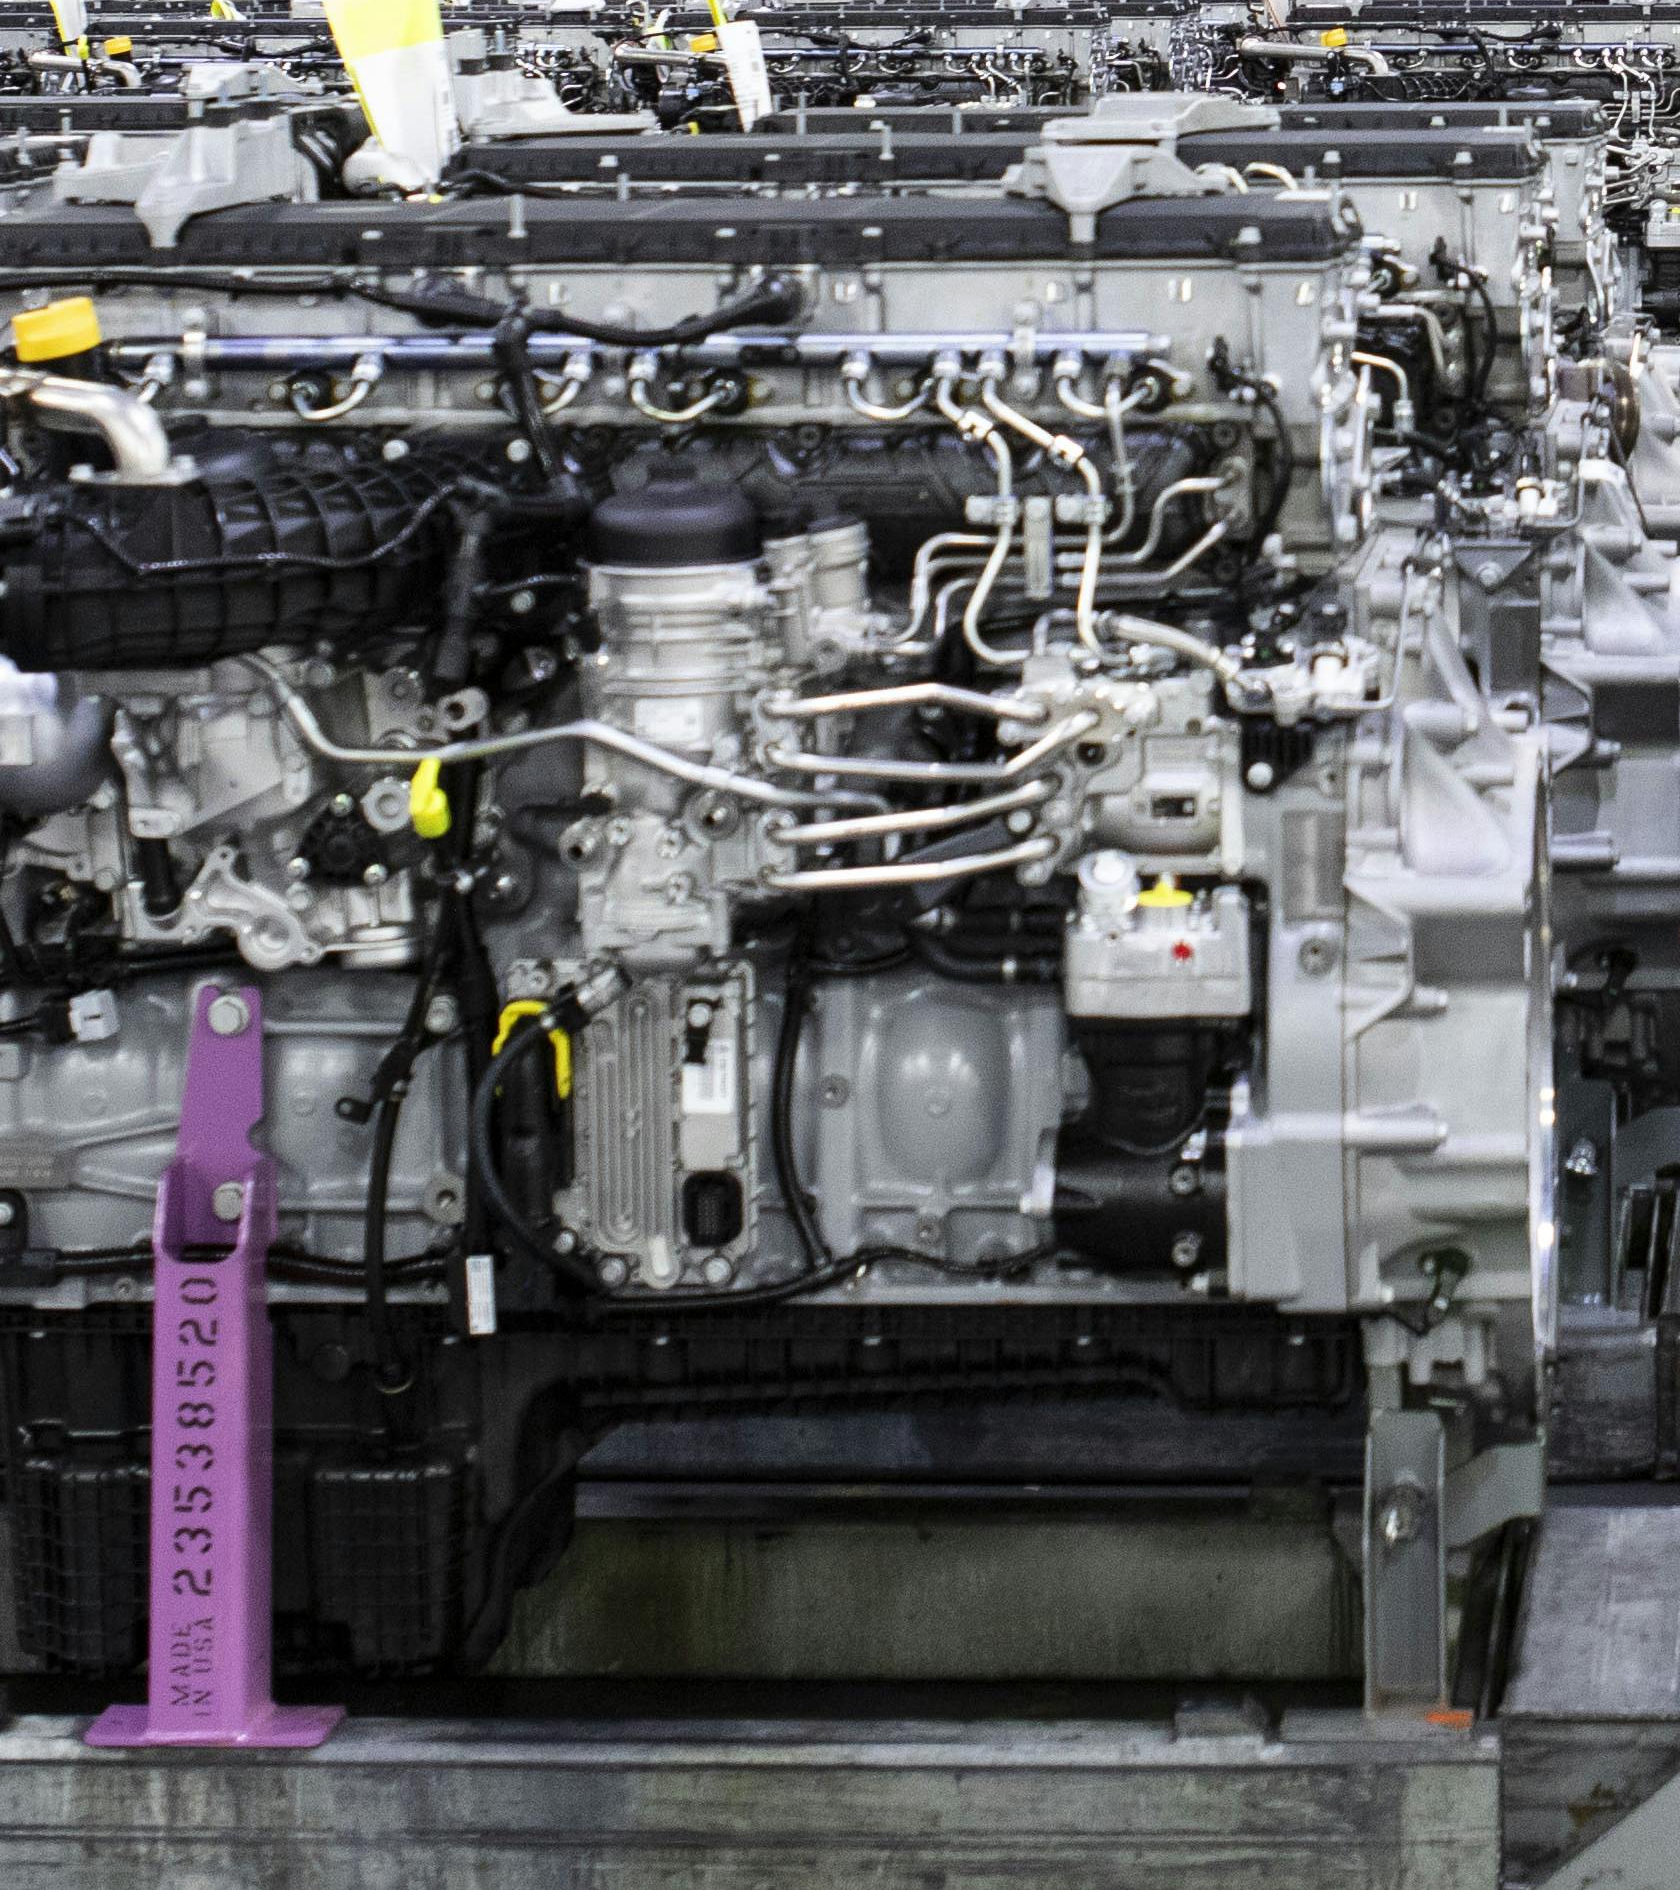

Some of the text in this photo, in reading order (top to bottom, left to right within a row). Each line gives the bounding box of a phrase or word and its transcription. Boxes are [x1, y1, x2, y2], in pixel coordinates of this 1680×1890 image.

[172, 1274, 219, 1598] 23538520
[170, 1621, 191, 1706] MADE
[193, 1617, 213, 1717] IN USA
